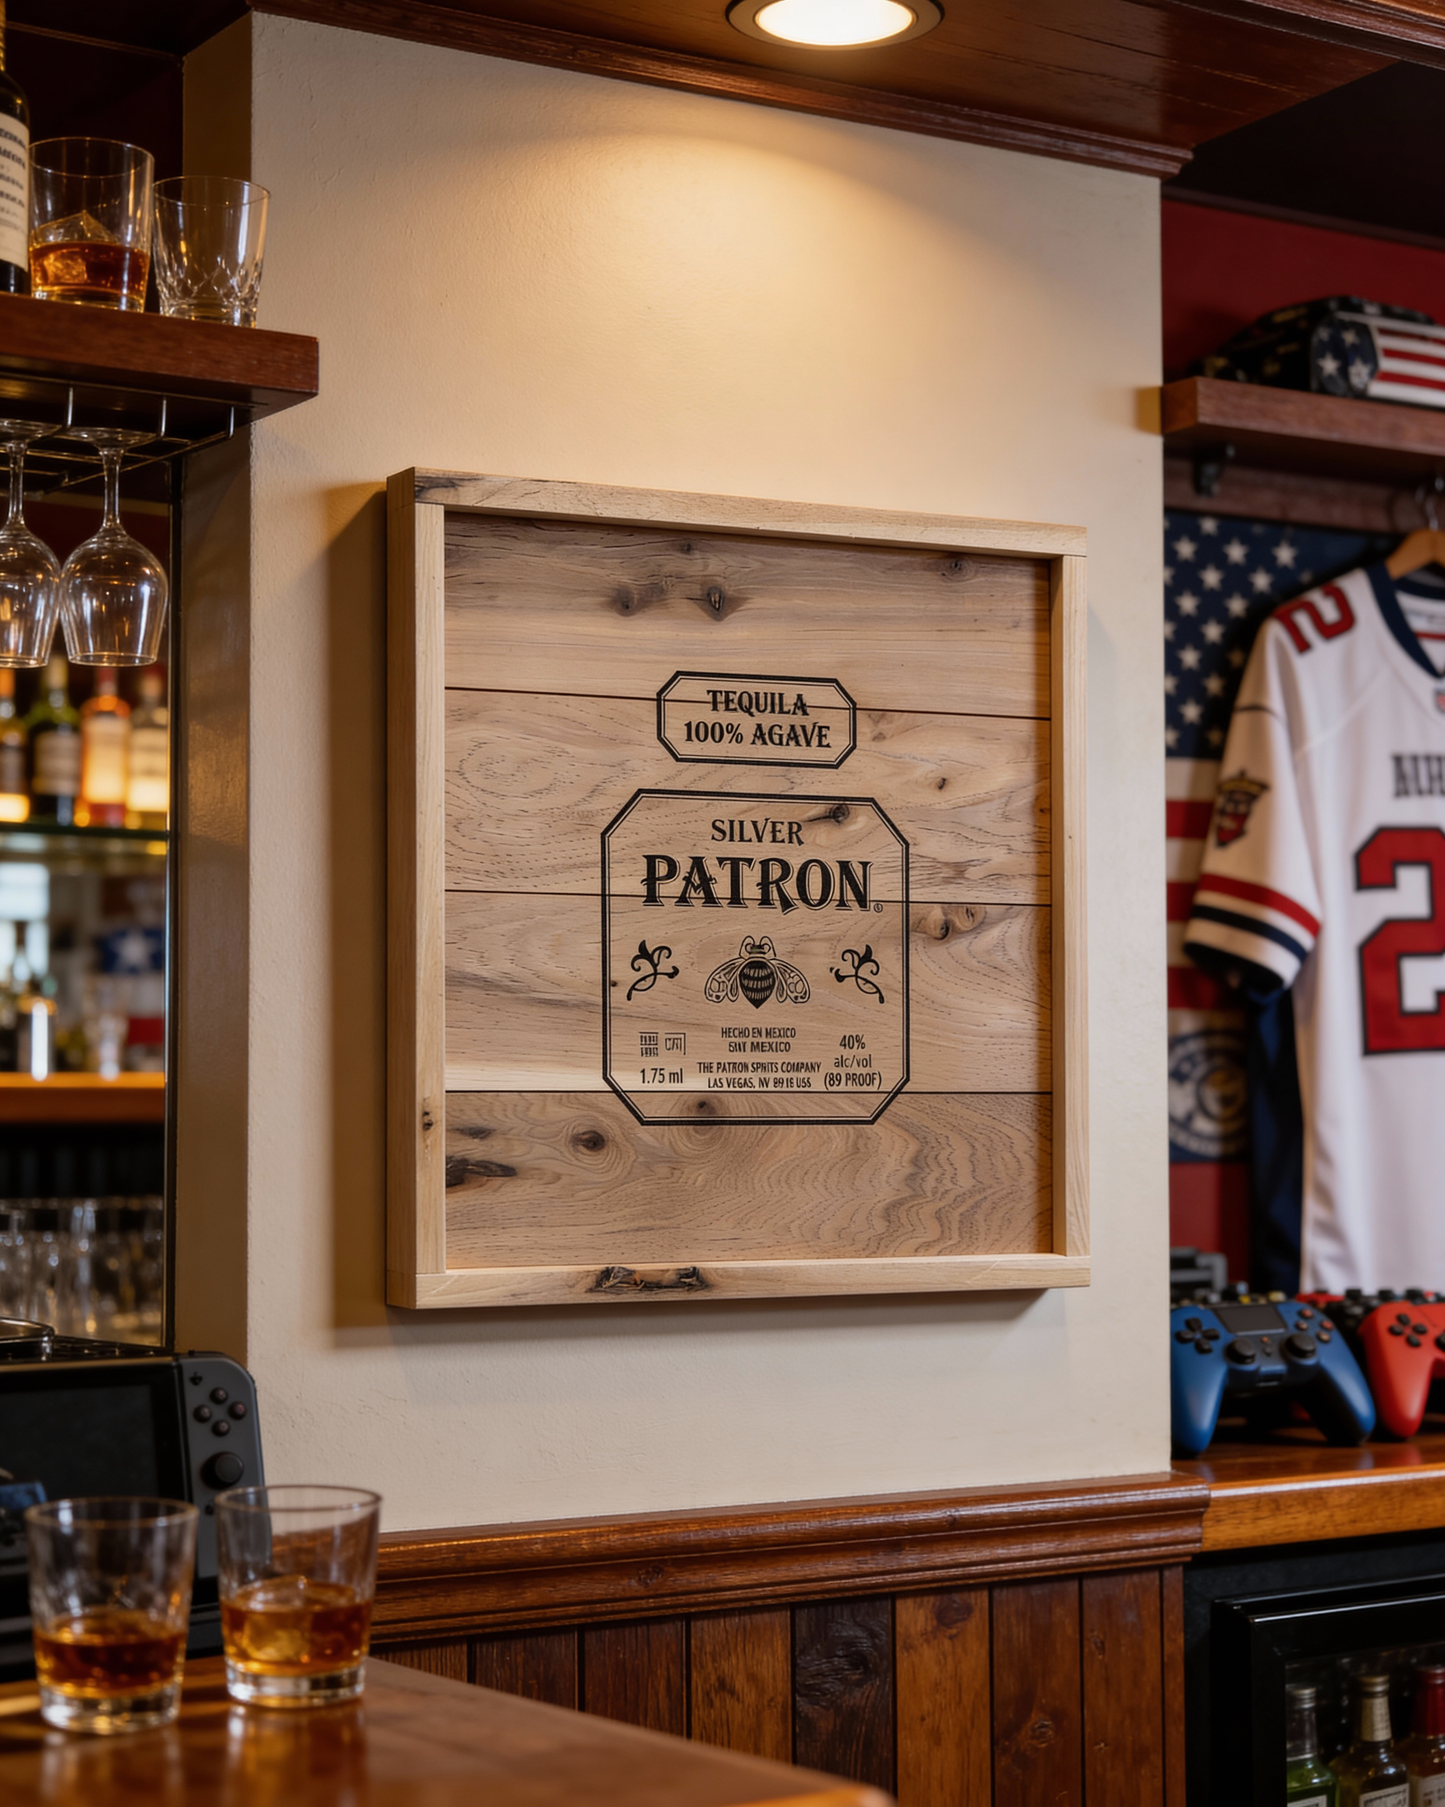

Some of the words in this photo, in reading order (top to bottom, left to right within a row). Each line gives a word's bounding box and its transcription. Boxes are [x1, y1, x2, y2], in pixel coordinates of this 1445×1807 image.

[706, 689, 810, 717] TEQUILA
[684, 720, 744, 744] 100%
[750, 721, 832, 748] AGAVE
[710, 817, 805, 846] SILVER
[640, 854, 874, 915] PATRON
[721, 1027, 750, 1039] HECHO
[751, 1027, 763, 1039] EN
[765, 1027, 797, 1039] MEXICO
[750, 1041, 791, 1053] MEXICO
[839, 1034, 866, 1050] 40%
[697, 1061, 714, 1073] THE
[716, 1061, 749, 1073] PATRON
[781, 1061, 822, 1073] COMPANY
[833, 1053, 873, 1069] alc/vol
[640, 1067, 666, 1084] 1.75
[668, 1067, 684, 1084] ml
[707, 1077, 724, 1089] LAS
[758, 1077, 770, 1089] NV
[823, 1071, 842, 1090] (89
[845, 1071, 882, 1090] PROOF)
